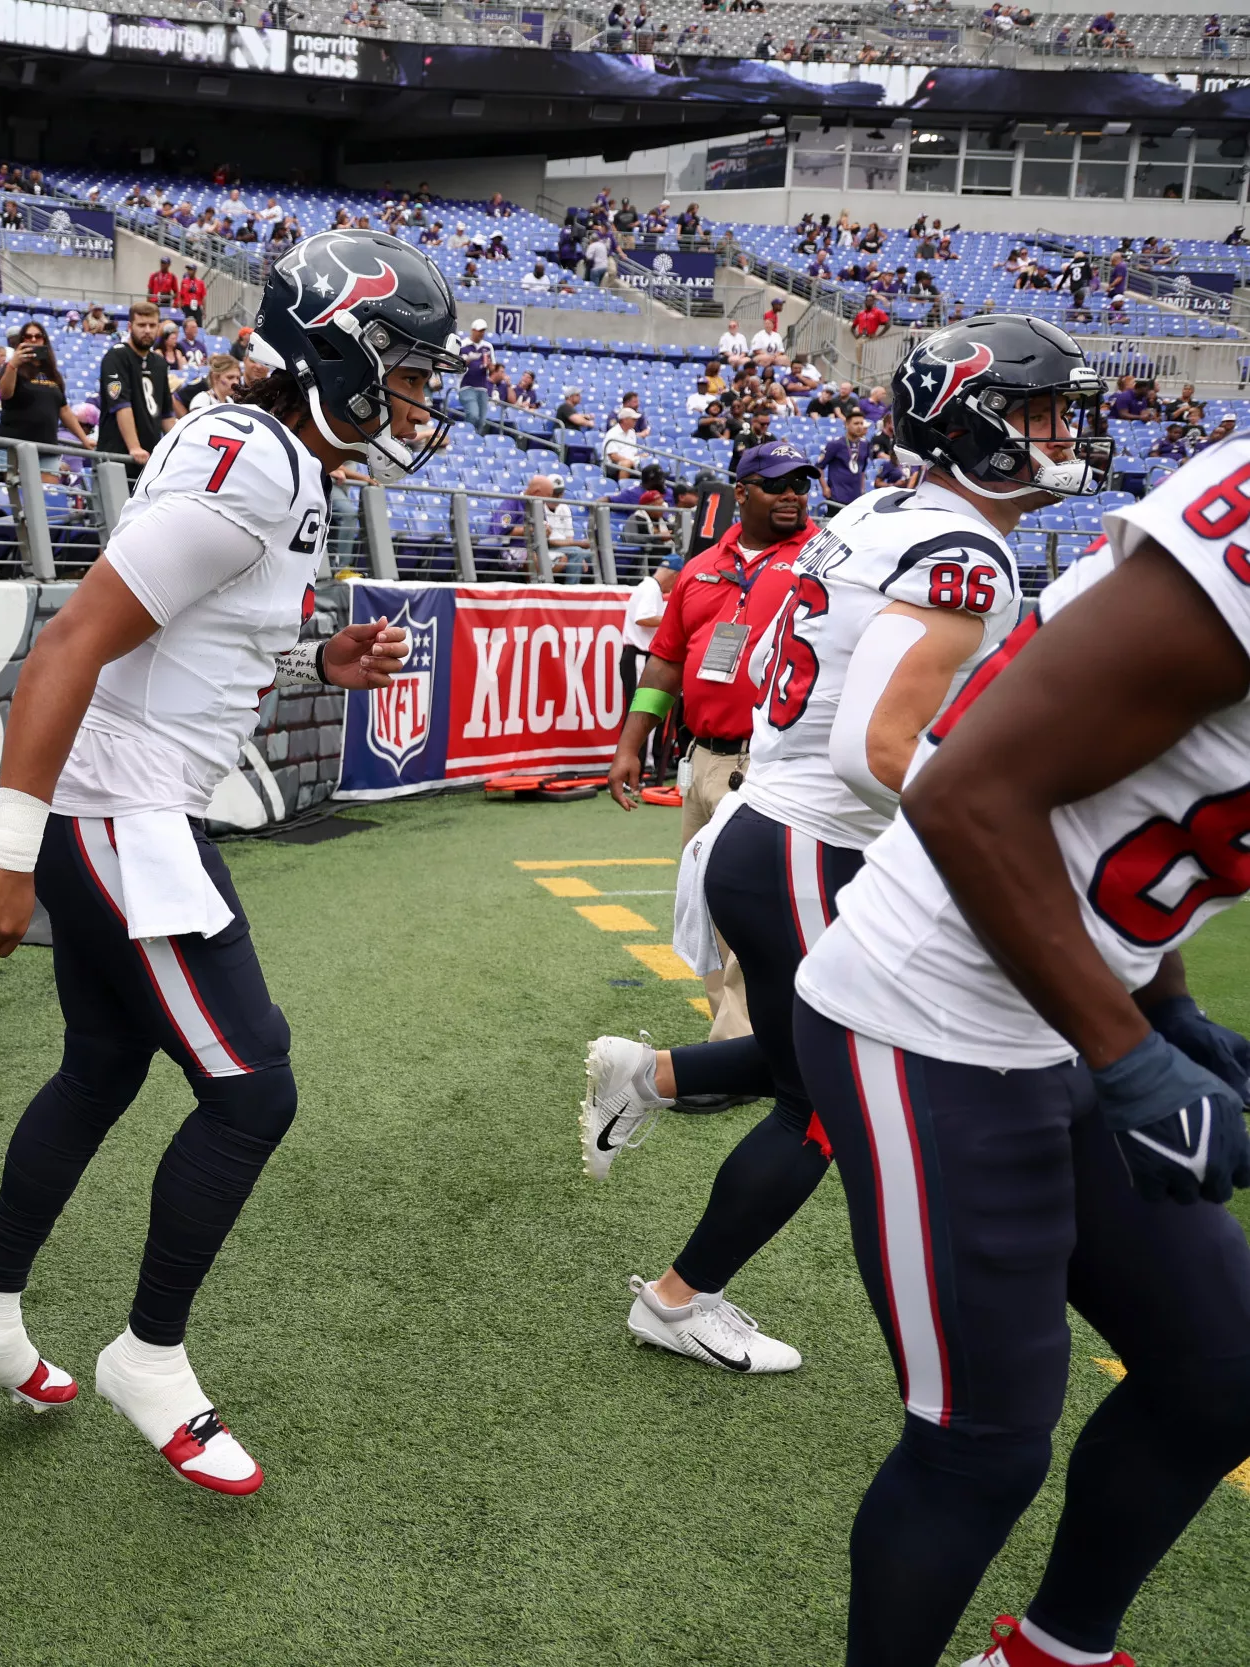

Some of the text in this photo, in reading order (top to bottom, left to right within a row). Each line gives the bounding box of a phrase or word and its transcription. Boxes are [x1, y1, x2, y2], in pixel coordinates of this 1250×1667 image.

[118, 24, 201, 57] PRESENTED
[293, 34, 359, 56] merritt
[292, 52, 359, 79] clubs
[497, 311, 521, 335] 121
[205, 434, 245, 493] 7
[701, 493, 721, 539] 1
[928, 562, 998, 614] 86
[462, 624, 625, 739] KICKO
[376, 677, 427, 749] NFL
